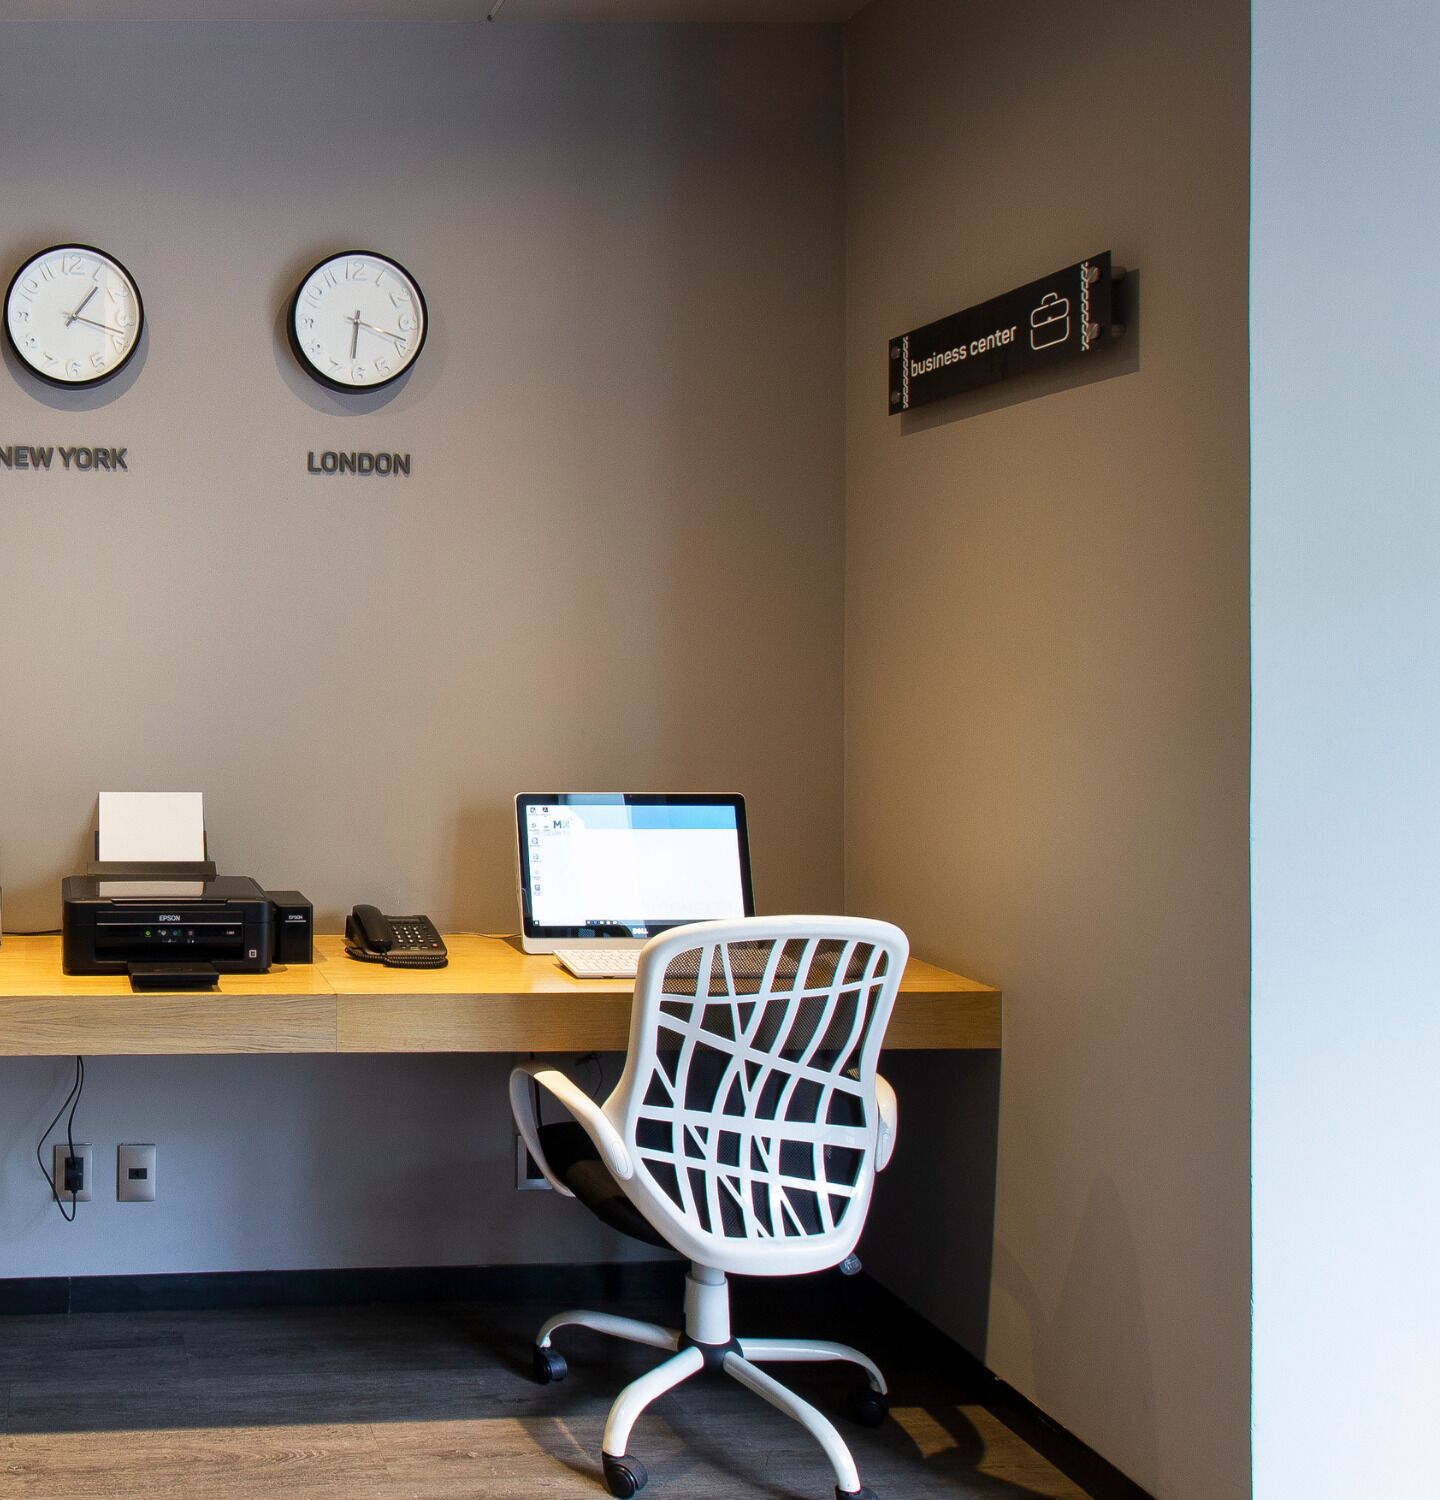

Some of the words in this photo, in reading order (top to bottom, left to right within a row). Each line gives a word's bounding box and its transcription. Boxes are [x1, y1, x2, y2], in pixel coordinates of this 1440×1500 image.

[38, 262, 54, 281] 11
[61, 254, 85, 275] 12
[345, 261, 367, 282] 12
[323, 267, 337, 288] 11
[16, 278, 38, 302] 10
[106, 284, 130, 303] 2
[304, 286, 323, 309] 10
[388, 288, 411, 308] 2
[911, 343, 967, 378] business
[969, 325, 1017, 356] center
[65, 360, 81, 377] 6
[90, 352, 105, 373] 5
[374, 357, 391, 377] 5
[350, 367, 365, 382] 6
[59, 446, 128, 471] YORK
[307, 451, 411, 476] LONDON
[632, 927, 649, 935] DELL
